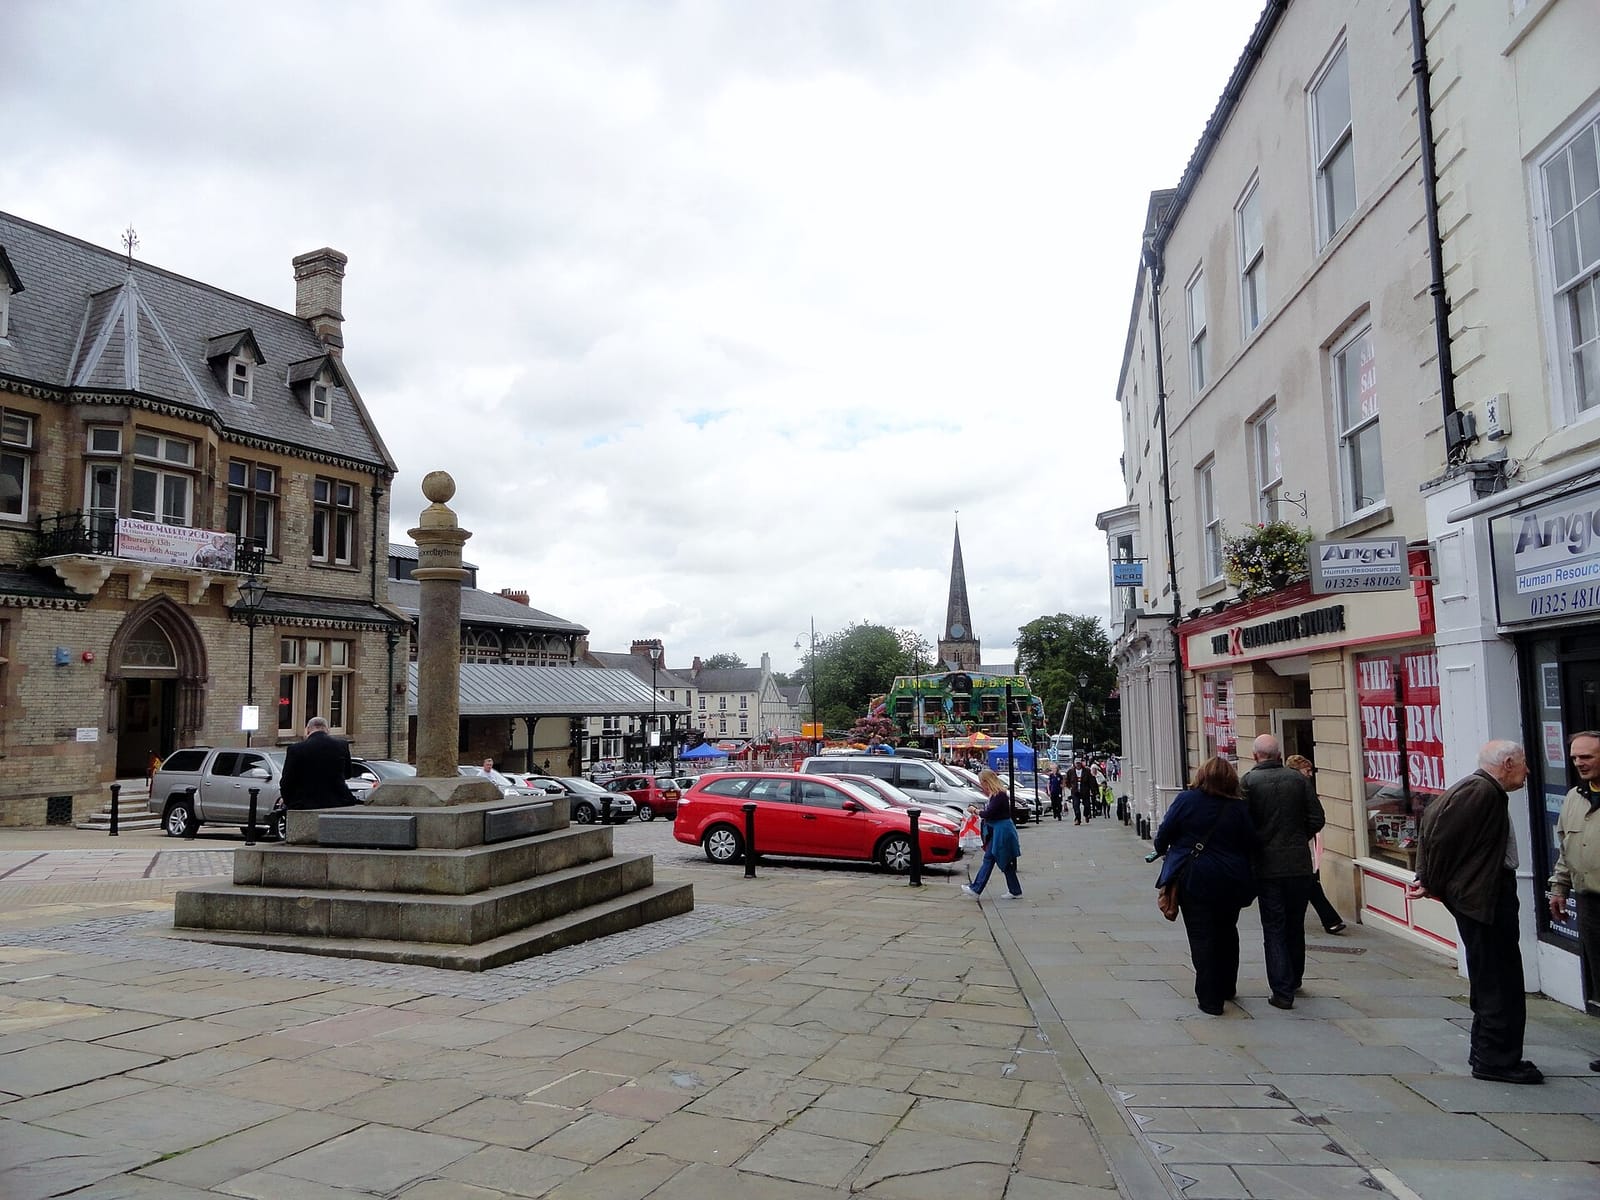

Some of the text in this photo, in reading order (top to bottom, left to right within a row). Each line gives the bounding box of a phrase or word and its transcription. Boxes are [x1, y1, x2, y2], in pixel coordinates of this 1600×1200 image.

[120, 534, 155, 545] Thursday
[187, 529, 209, 540] 2015
[120, 543, 147, 553] Sunday
[164, 549, 188, 558] August
[1322, 542, 1397, 563] Angel
[1323, 568, 1350, 576] Human
[1351, 566, 1388, 574] Resources
[1325, 576, 1401, 589] 01325 481026
[1519, 574, 1552, 589] Human
[1531, 592, 1567, 616] 01325
[1360, 660, 1391, 690] THE
[1361, 705, 1398, 741] BIG
[1368, 750, 1400, 783] SALE
[1408, 754, 1445, 790] SAL
